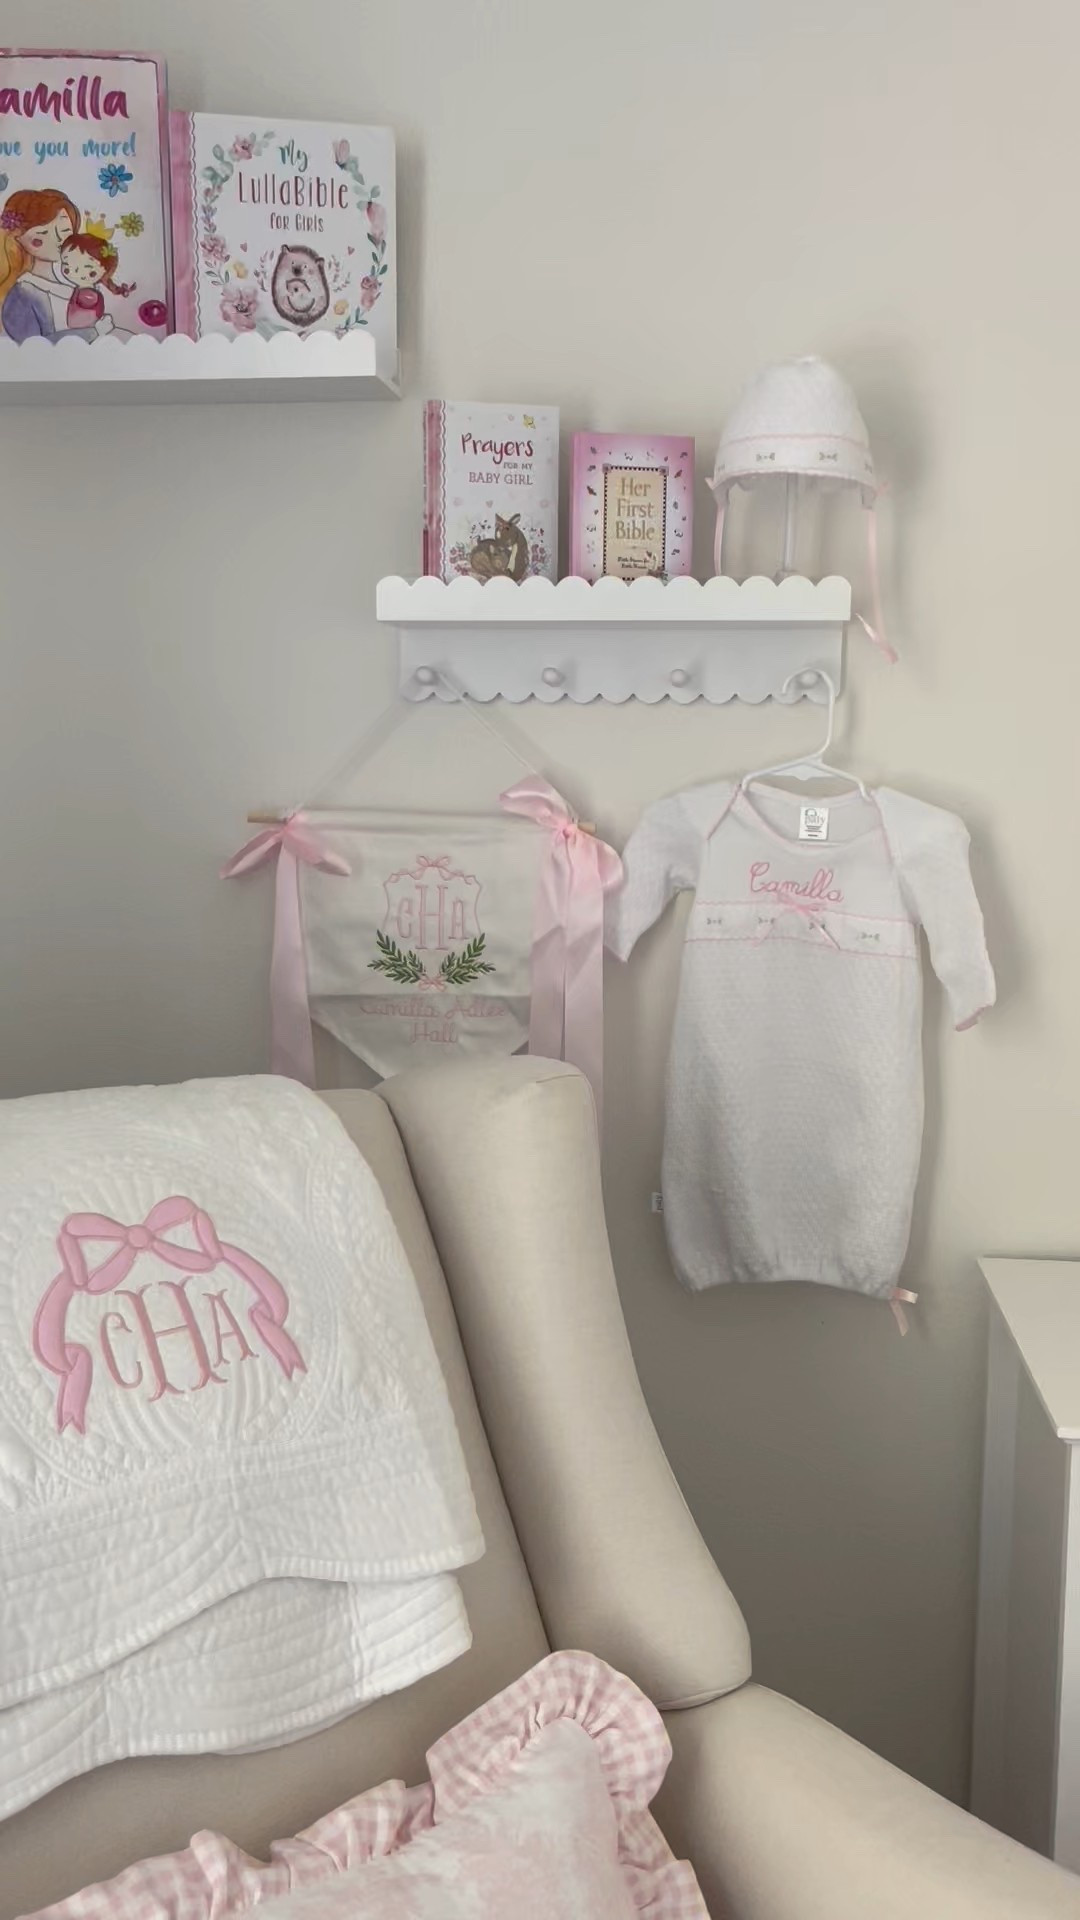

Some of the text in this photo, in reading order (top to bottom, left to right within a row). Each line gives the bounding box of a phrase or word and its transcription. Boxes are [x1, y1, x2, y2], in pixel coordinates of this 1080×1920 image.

[0, 75, 130, 123] amilla
[34, 140, 69, 165] you
[82, 131, 137, 158] more!
[278, 138, 309, 173] My
[238, 171, 349, 209] LullaBible
[460, 432, 534, 465] Prayers
[468, 471, 534, 486] BABY GIRL
[503, 461, 534, 471] FOR MY
[619, 477, 652, 497] Her
[616, 497, 654, 518] First
[615, 519, 656, 541] Bible
[749, 861, 843, 903] Camilla
[409, 1021, 459, 1043] Hall
[100, 1275, 260, 1403] CHA
